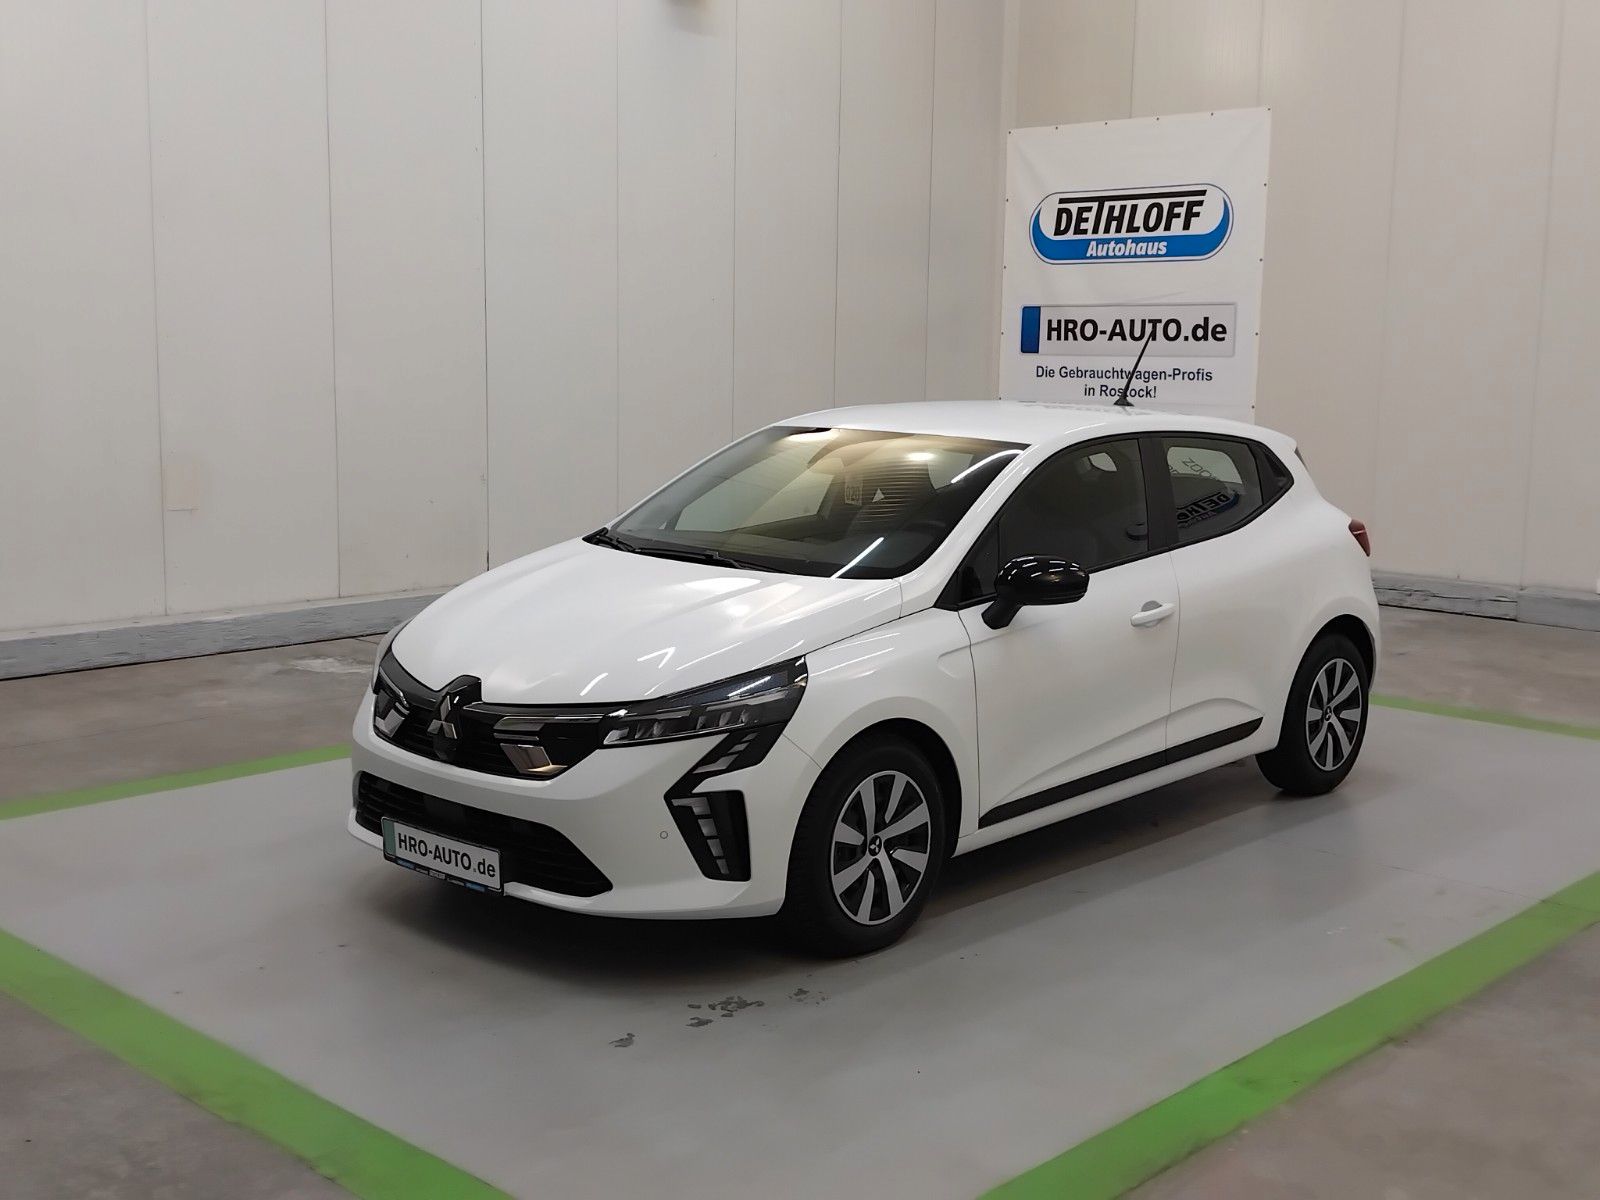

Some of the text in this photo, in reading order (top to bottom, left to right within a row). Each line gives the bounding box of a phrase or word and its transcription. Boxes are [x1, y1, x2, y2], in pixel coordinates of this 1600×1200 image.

[1053, 190, 1207, 236] DETHLOFF
[1086, 240, 1168, 257] Autohaus
[1046, 317, 1227, 342] HRO-AUTO.de
[1036, 366, 1055, 378] Die
[1084, 384, 1095, 397] in
[398, 832, 496, 878] HRO-AUTO.de
